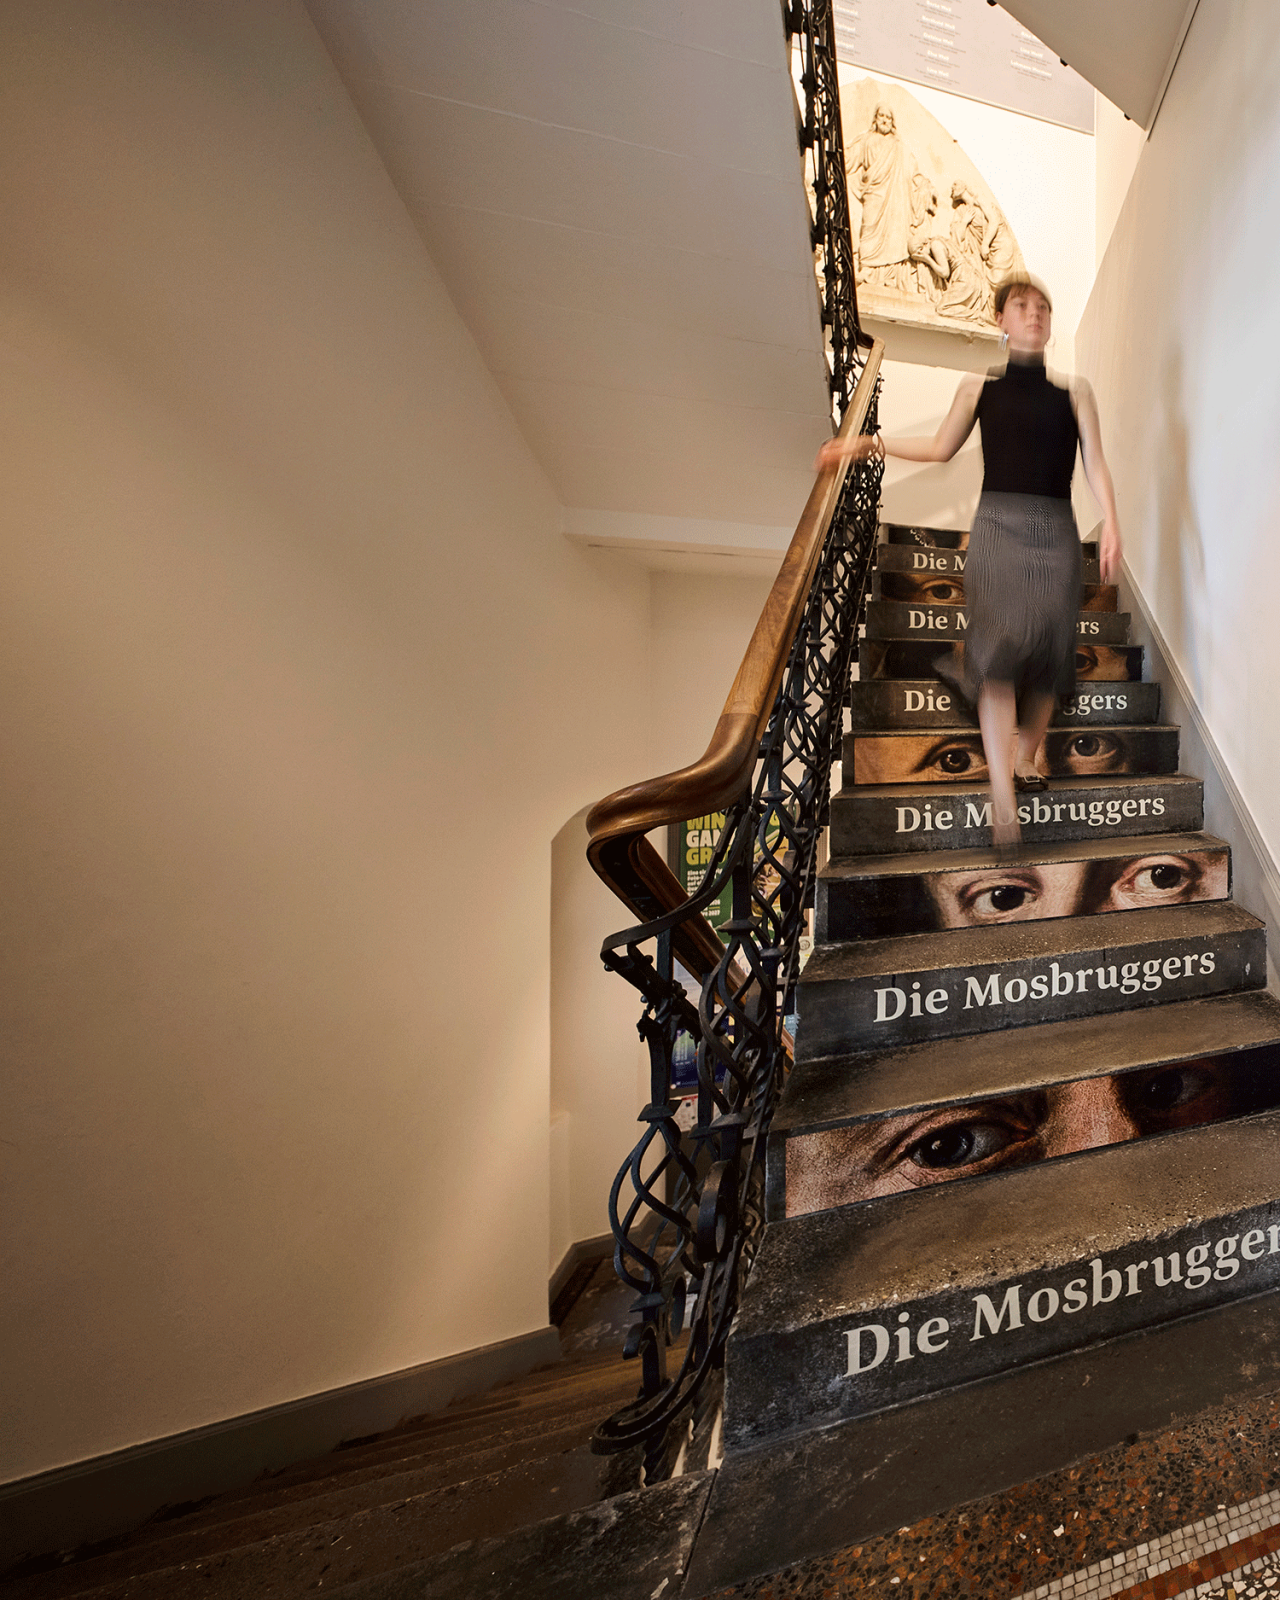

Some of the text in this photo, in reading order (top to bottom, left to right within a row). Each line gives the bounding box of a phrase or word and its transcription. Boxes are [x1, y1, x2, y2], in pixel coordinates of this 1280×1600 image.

[912, 552, 948, 571] Die
[908, 610, 949, 630] Die
[904, 689, 951, 712] Die
[895, 796, 1166, 834] Die Mosbruggers
[872, 952, 1216, 1023] Die Mosbruggers
[842, 1311, 950, 1377] Die
